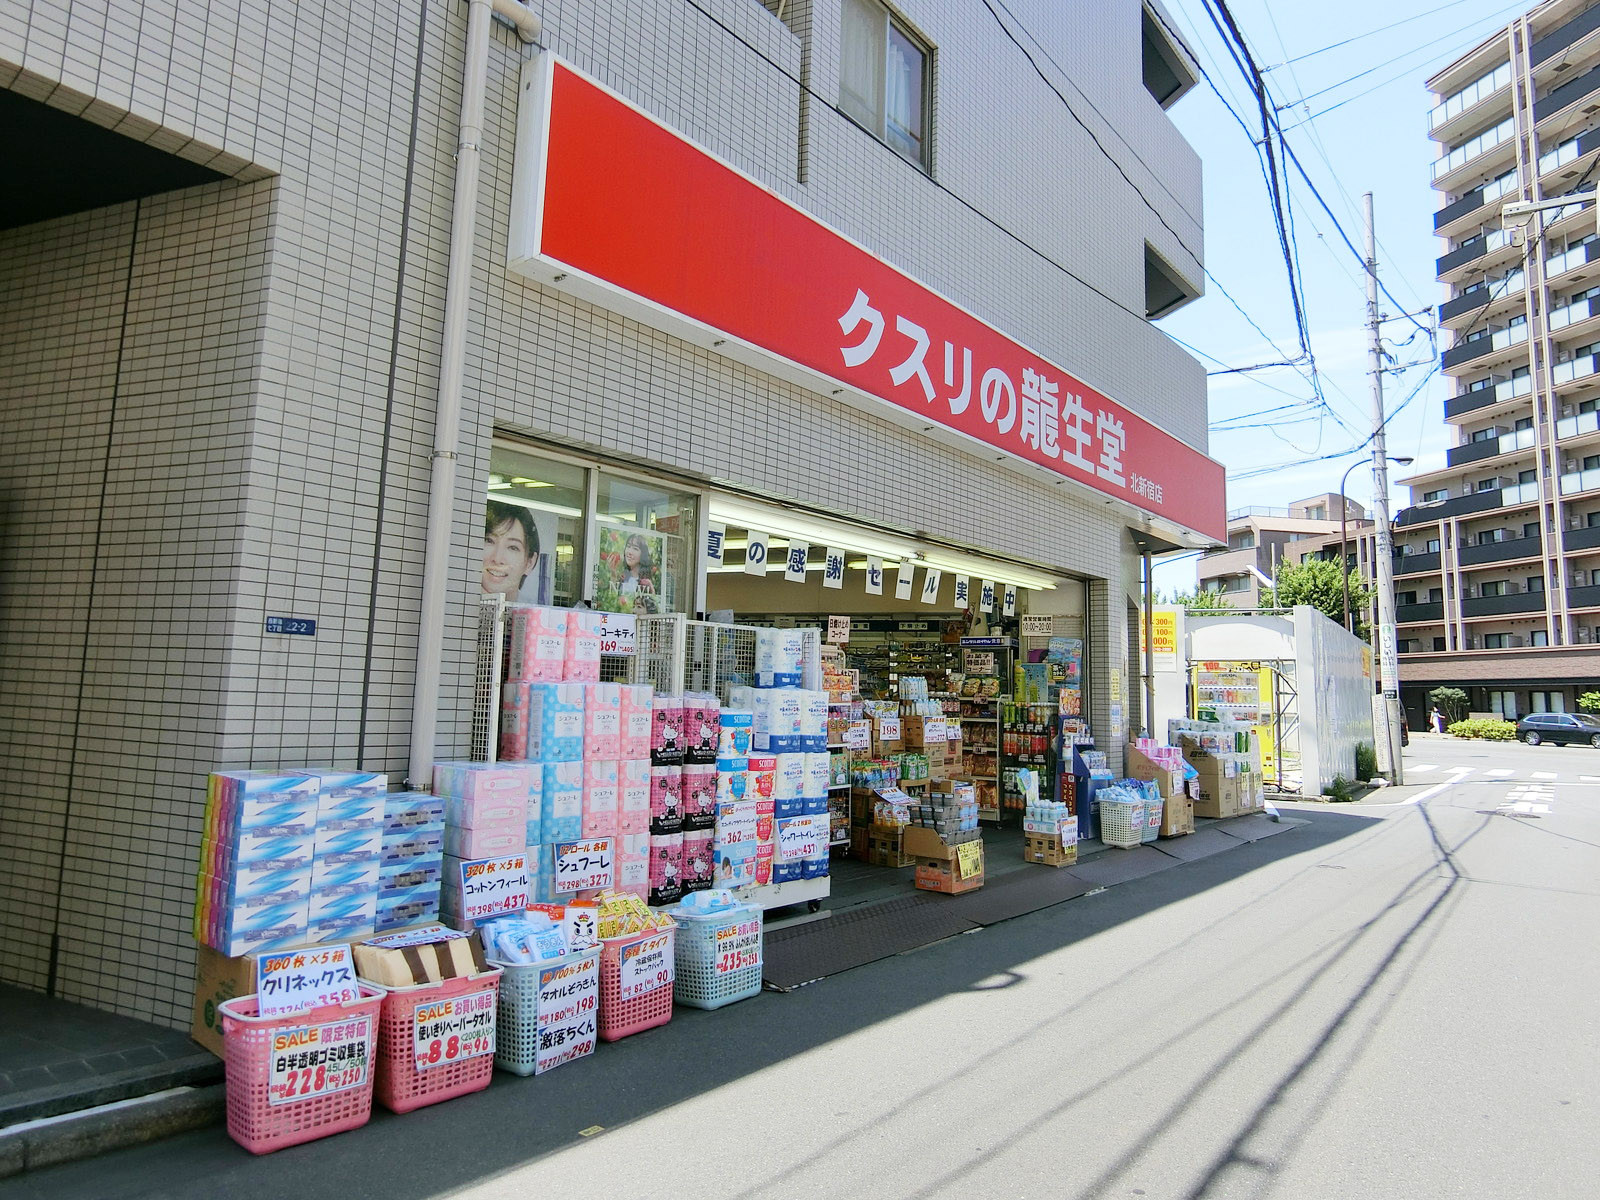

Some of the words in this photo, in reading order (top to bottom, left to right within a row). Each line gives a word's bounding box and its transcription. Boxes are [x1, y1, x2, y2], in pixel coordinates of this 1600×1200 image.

[837, 287, 1126, 488] クスリの龍生堂
[1130, 472, 1164, 504] 北新宿店
[829, 618, 849, 629] 日焼け止め
[831, 631, 846, 639] コーナー
[882, 726, 897, 735] 198
[727, 831, 742, 844] 362
[558, 855, 610, 873] シュフーレ
[465, 875, 528, 895] コットンフィール
[589, 874, 608, 886] 327
[504, 894, 526, 910] 437
[717, 925, 737, 940] SALE
[723, 951, 742, 972] 235
[263, 967, 352, 995] クリネックス
[657, 969, 668, 983] 90
[540, 976, 596, 1002] タオルぞうきん
[417, 1002, 452, 1022] SALE
[455, 994, 492, 1016] お買い得品
[576, 995, 594, 1013] 198
[275, 1028, 318, 1050] SALE
[321, 1020, 367, 1044] 限定特価
[539, 1019, 595, 1050] 激落ちくん
[276, 1041, 366, 1072] 白半透明ゴミ収集袋
[428, 1035, 459, 1063] 88
[474, 1037, 489, 1052] 96
[570, 1040, 592, 1059] 298
[285, 1065, 326, 1097] 228
[342, 1067, 361, 1086] 250
